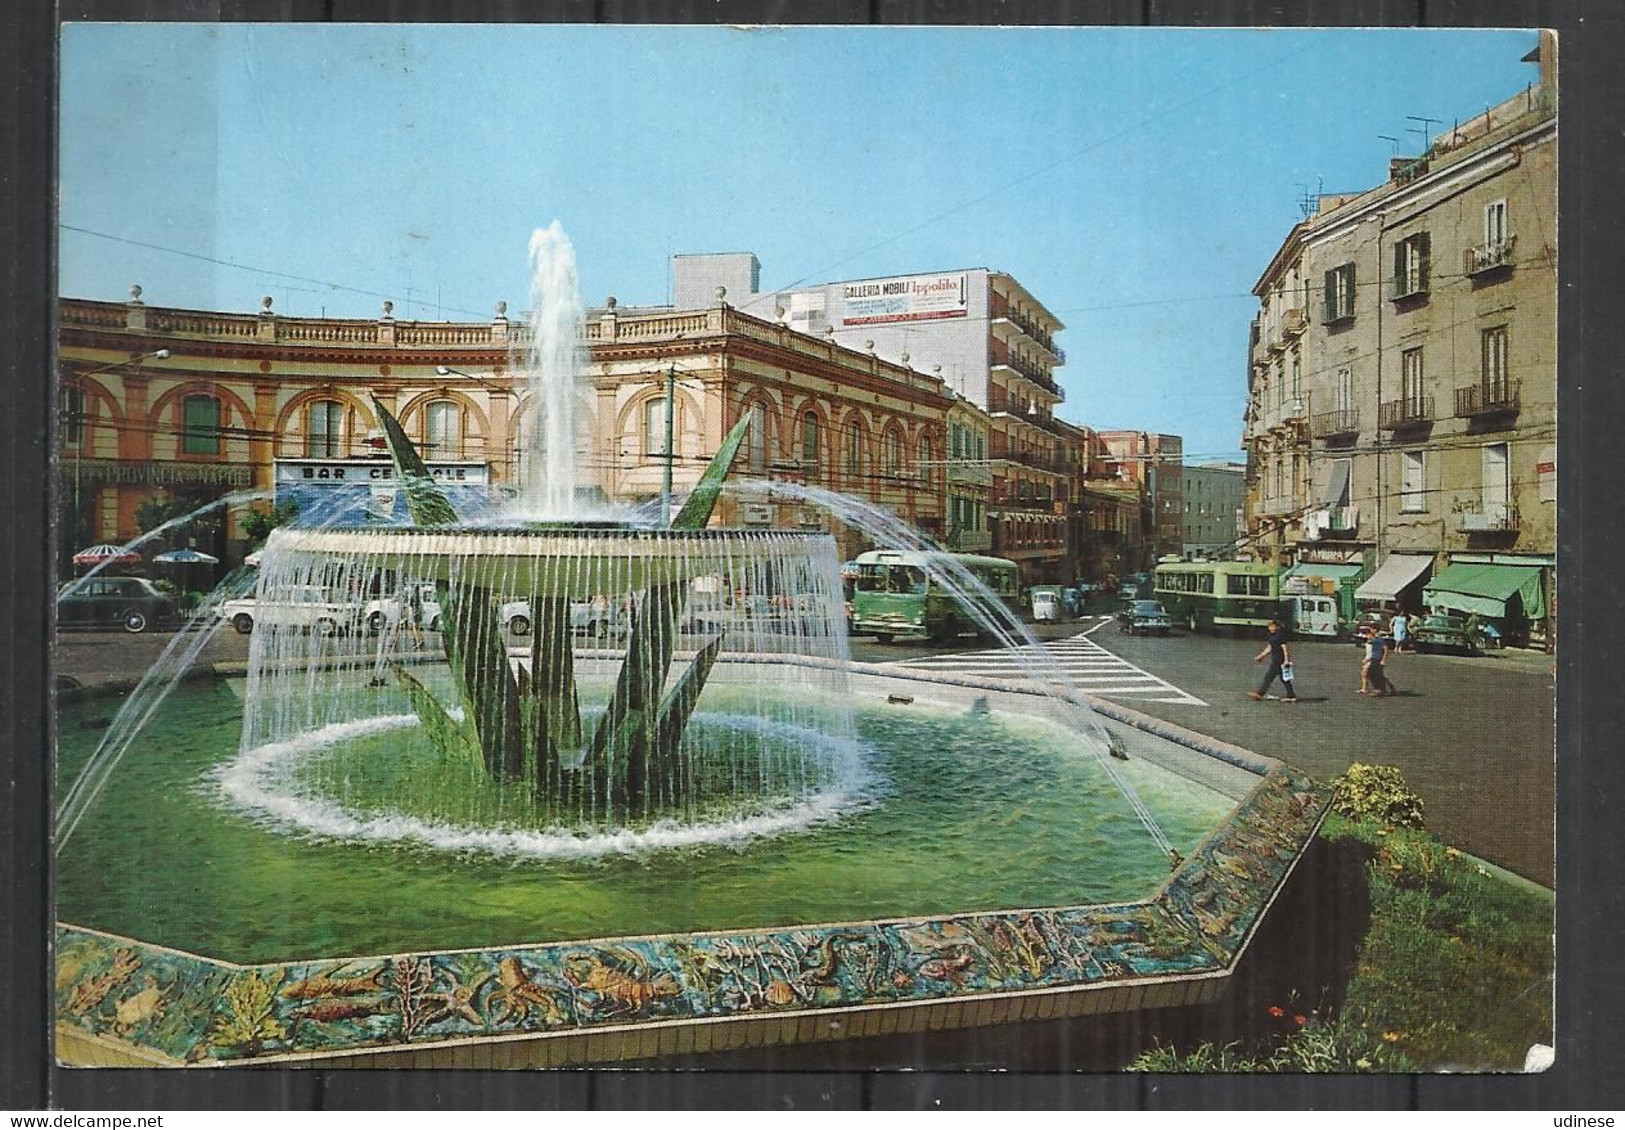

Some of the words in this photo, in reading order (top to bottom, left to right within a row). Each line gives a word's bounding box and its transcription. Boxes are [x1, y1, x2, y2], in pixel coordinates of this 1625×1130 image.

[844, 284, 880, 298] GALLERIA
[882, 281, 909, 295] MOBILI
[302, 467, 346, 480] BAR
[369, 468, 466, 481] CEALE
